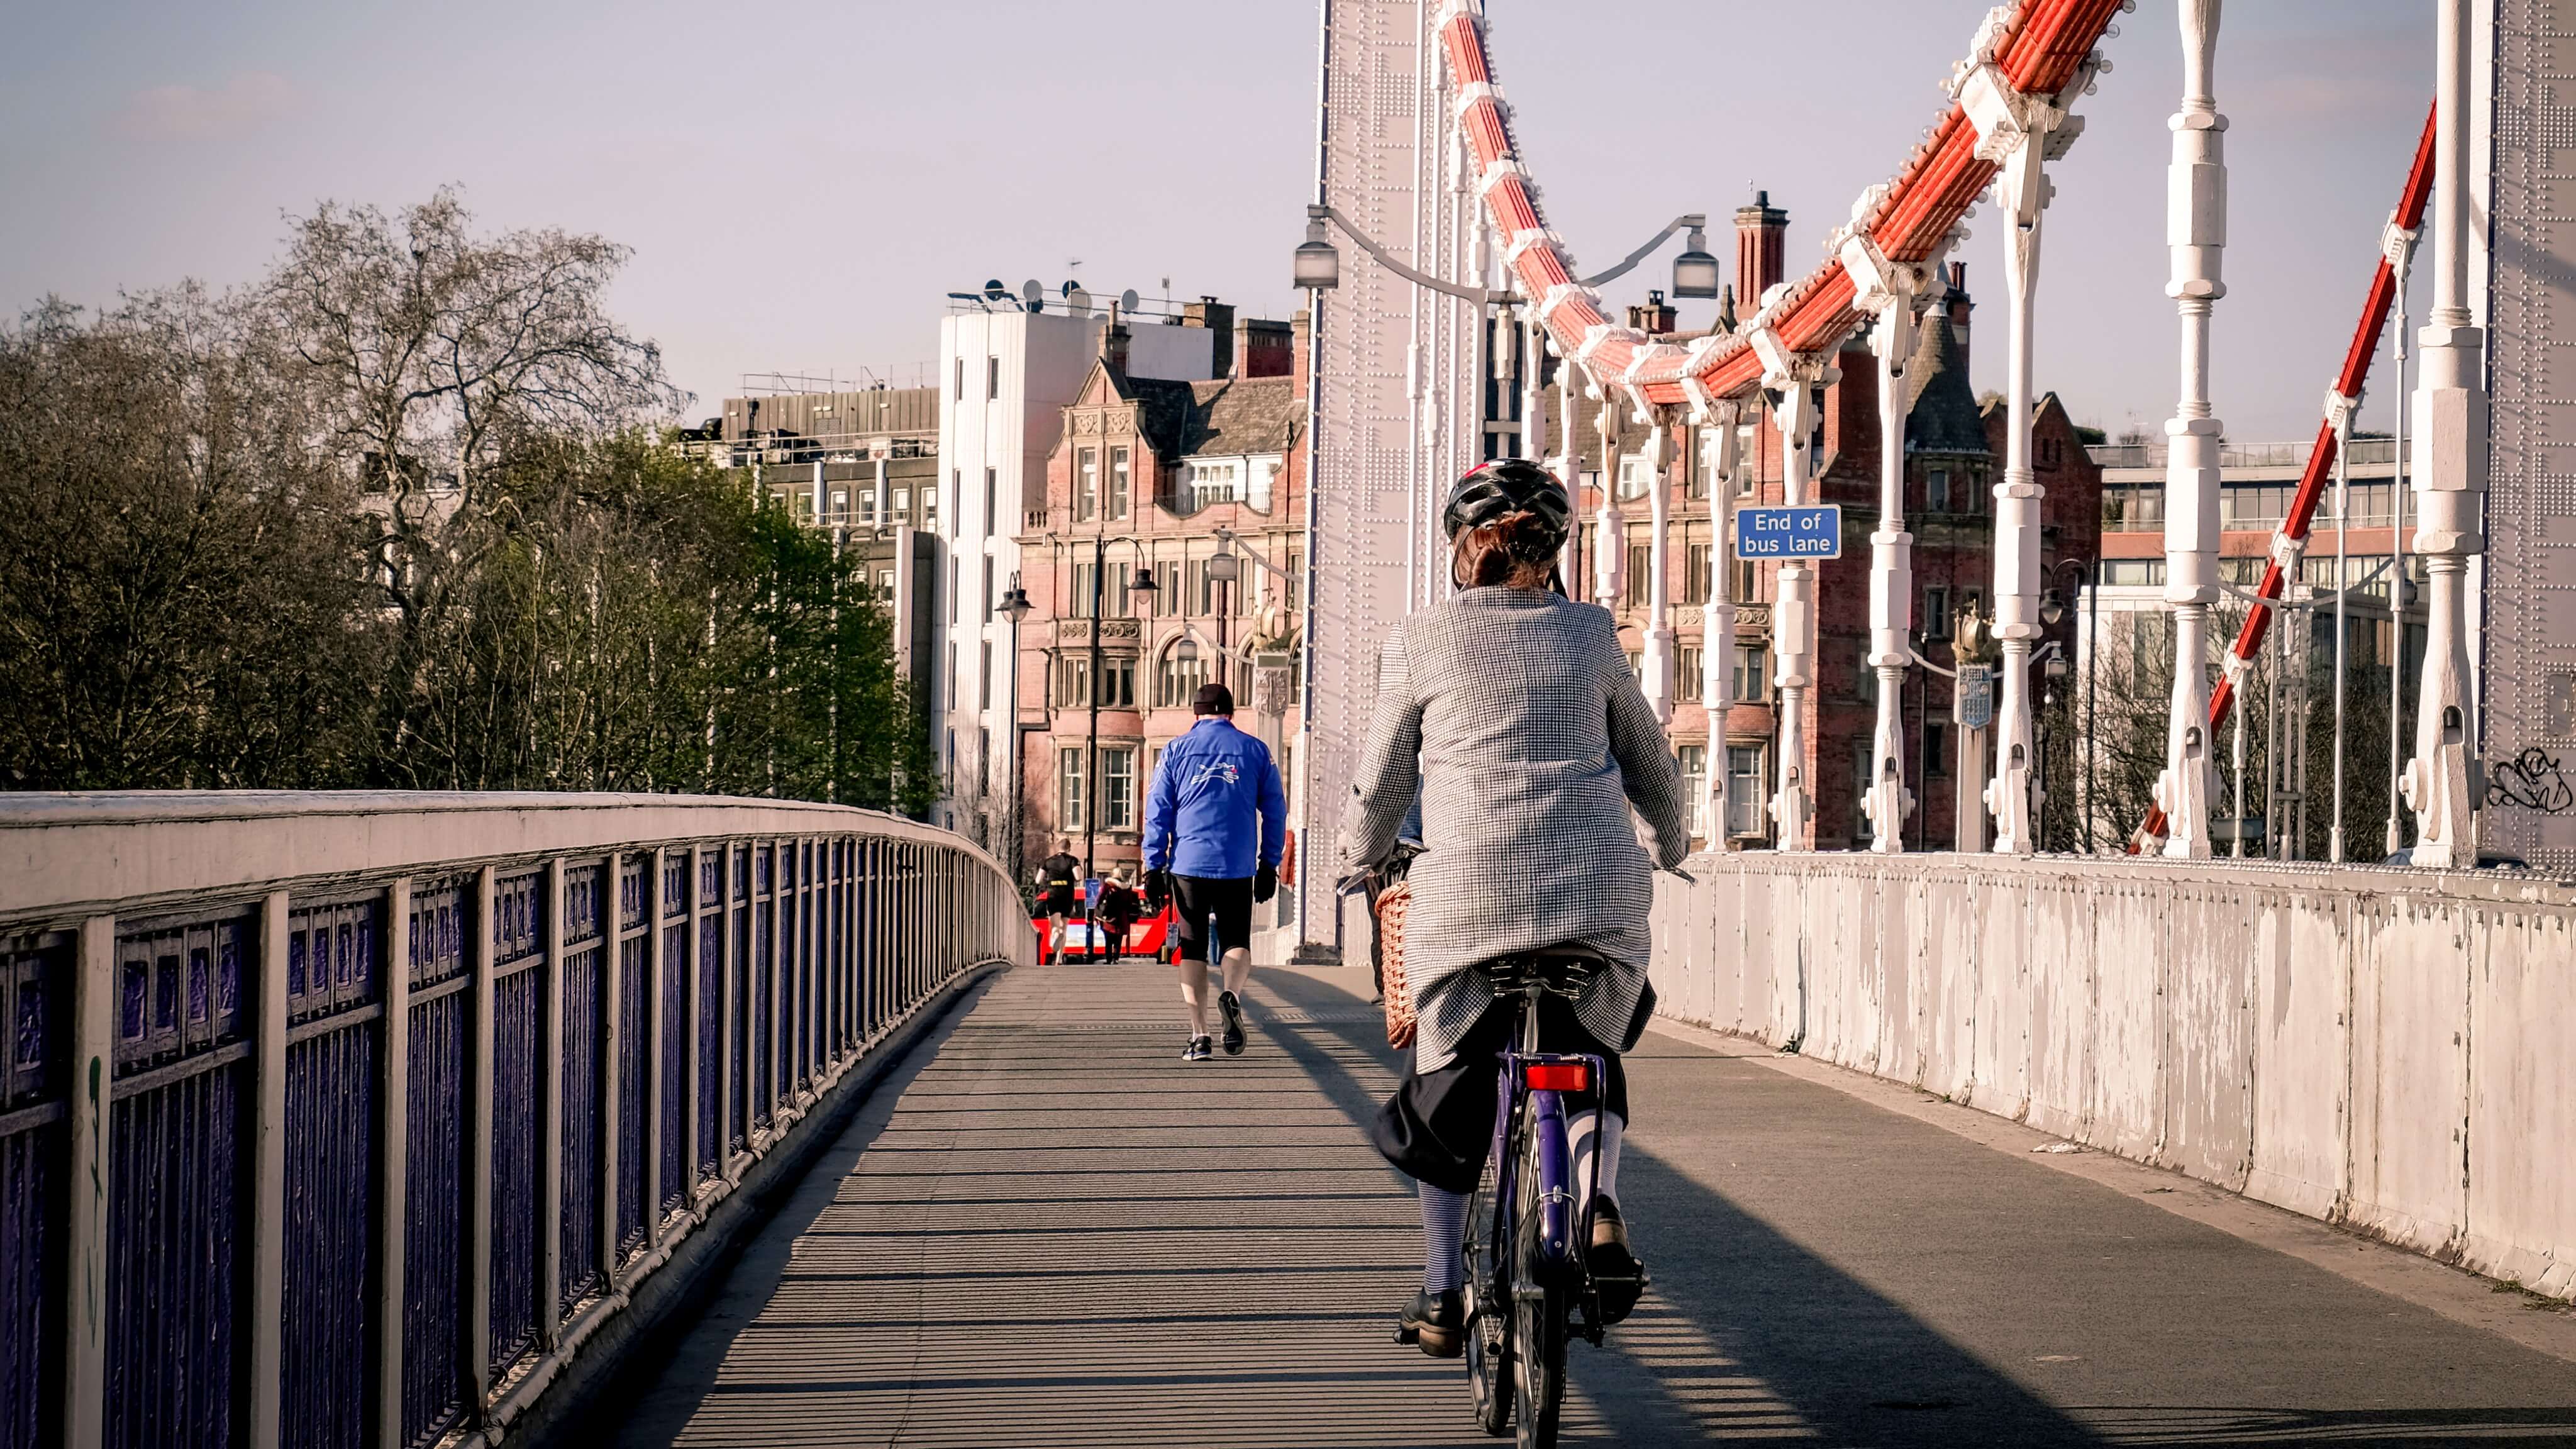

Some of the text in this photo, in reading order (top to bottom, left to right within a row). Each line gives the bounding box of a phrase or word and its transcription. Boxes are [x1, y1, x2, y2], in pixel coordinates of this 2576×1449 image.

[1755, 513, 1821, 531] End of
[1745, 535, 1831, 553] bus lane
